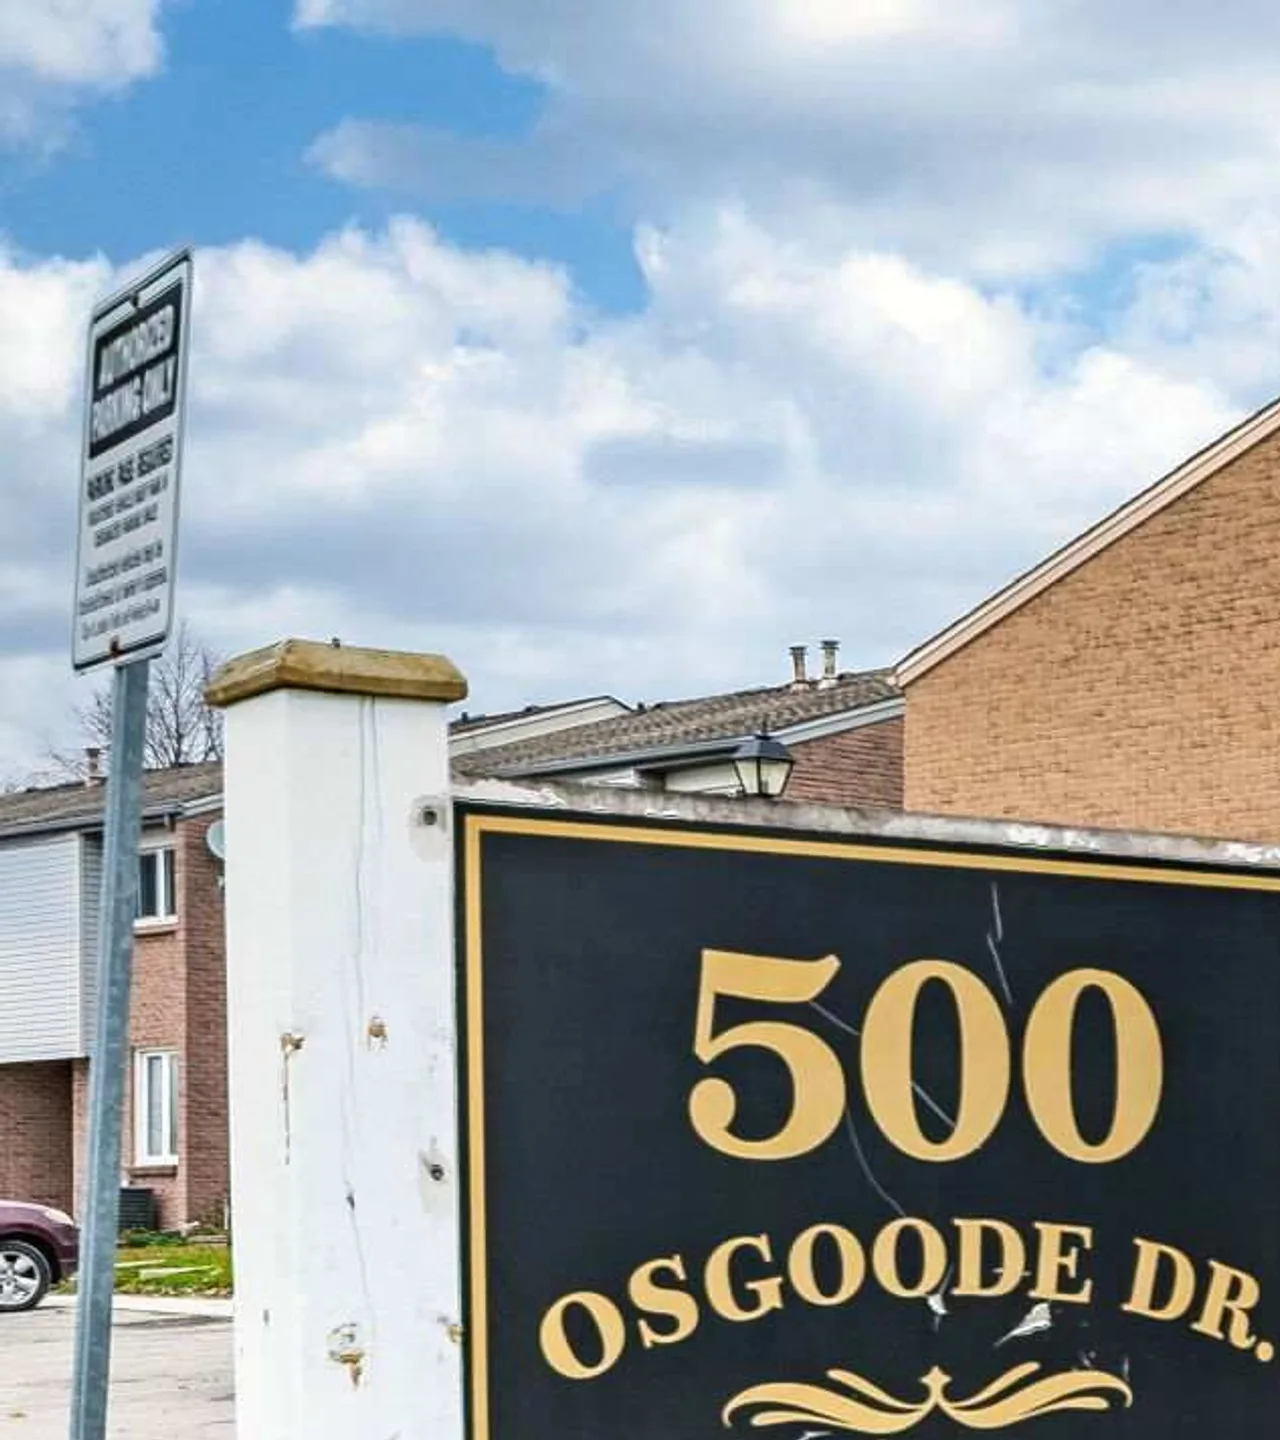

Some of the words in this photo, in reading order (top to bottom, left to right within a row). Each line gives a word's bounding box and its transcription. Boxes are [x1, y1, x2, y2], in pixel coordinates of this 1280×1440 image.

[688, 947, 1163, 1164] 500
[539, 1216, 1094, 1380] OSGOODE
[1120, 1236, 1275, 1363] DR.
